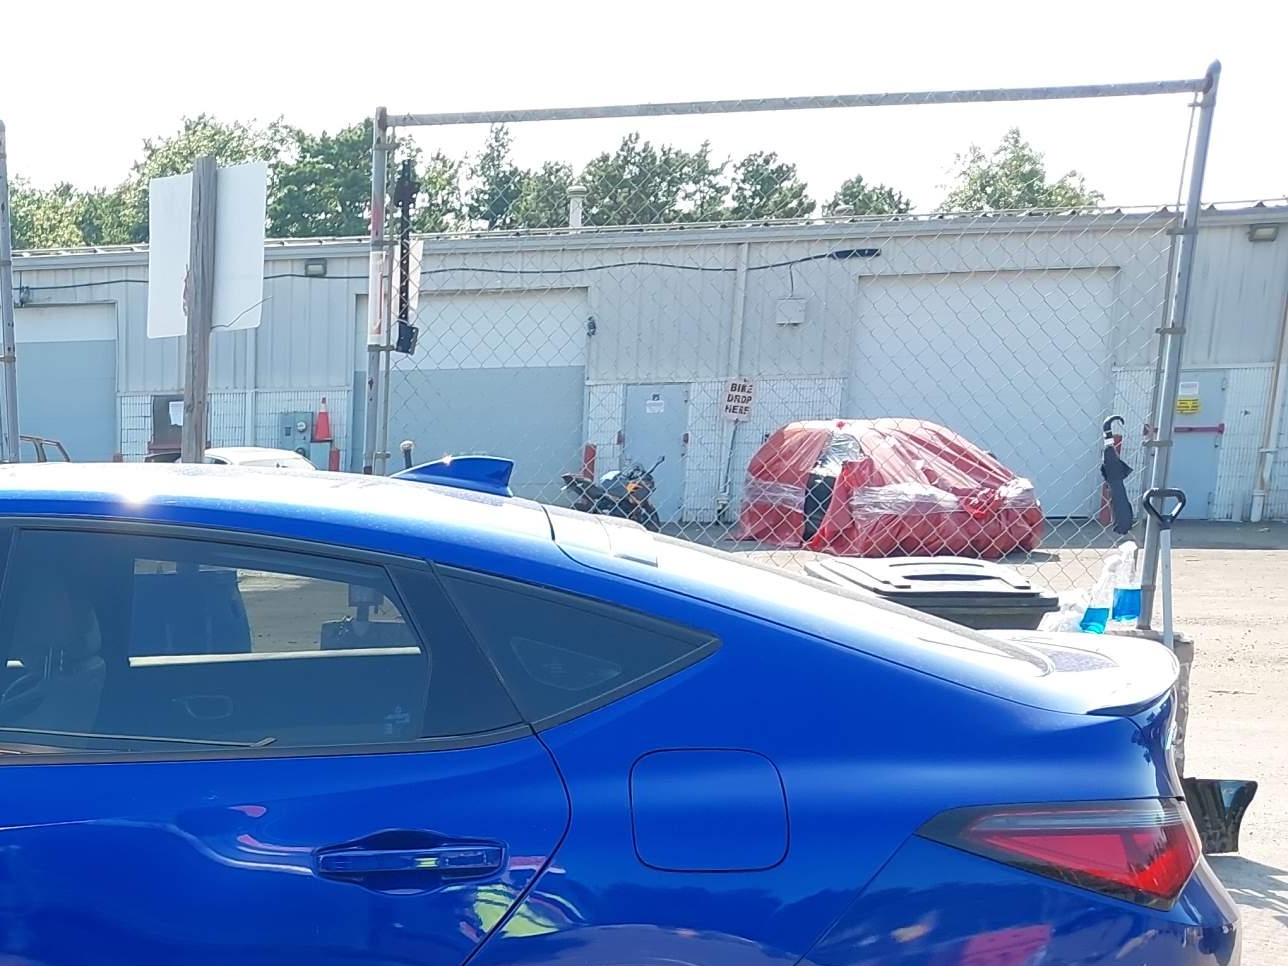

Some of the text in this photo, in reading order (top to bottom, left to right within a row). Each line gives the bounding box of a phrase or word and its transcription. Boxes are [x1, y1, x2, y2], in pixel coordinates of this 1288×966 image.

[730, 383, 753, 393] BIKE
[726, 394, 752, 404] DROP
[724, 405, 750, 415] HERE
